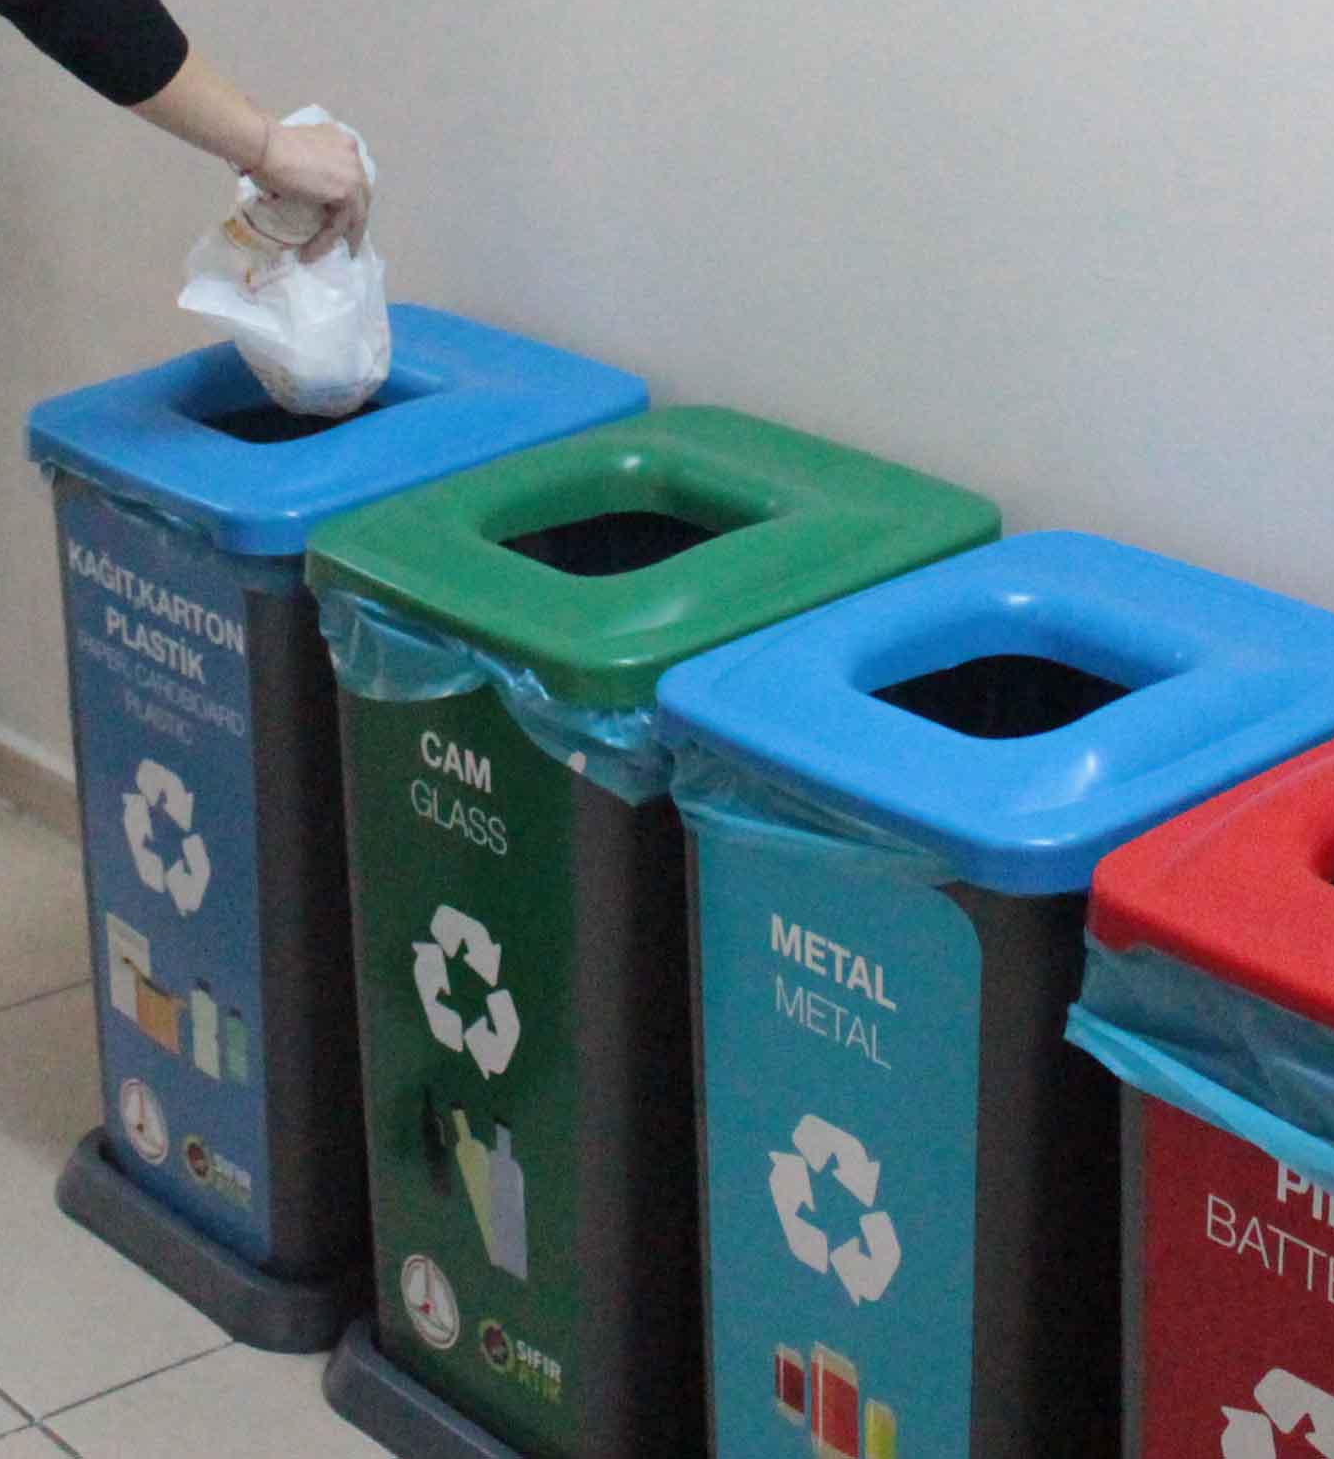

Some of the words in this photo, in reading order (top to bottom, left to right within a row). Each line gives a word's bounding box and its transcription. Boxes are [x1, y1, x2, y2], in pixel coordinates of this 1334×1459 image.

[106, 605, 207, 685] PLASTİK
[420, 730, 492, 794] CAM
[410, 779, 508, 855] GLASS
[771, 913, 898, 1013] METAL
[775, 973, 893, 1071] METAL
